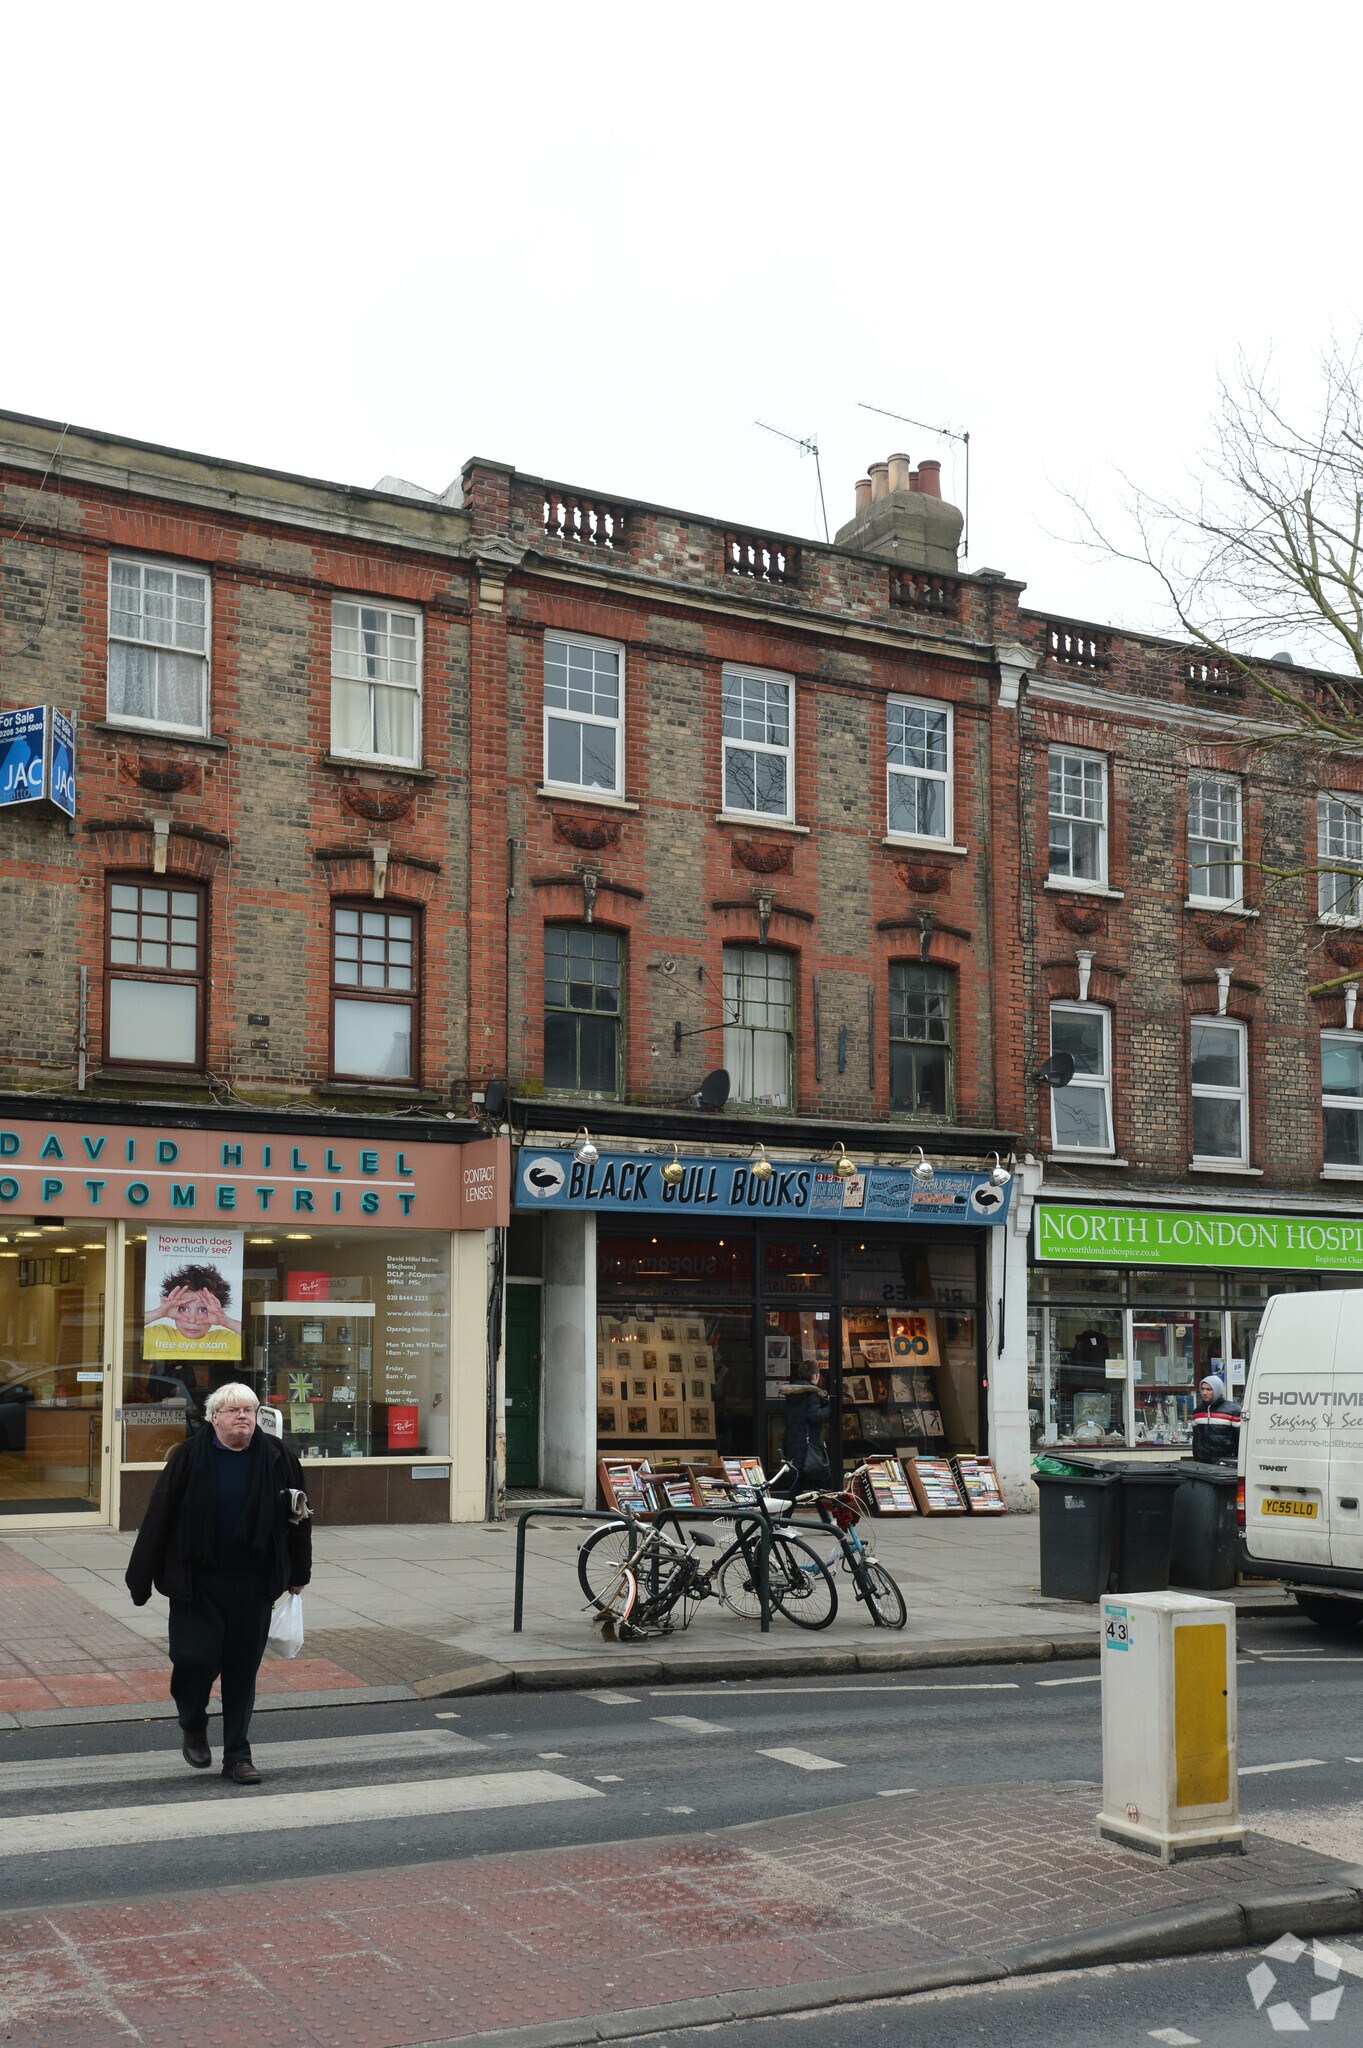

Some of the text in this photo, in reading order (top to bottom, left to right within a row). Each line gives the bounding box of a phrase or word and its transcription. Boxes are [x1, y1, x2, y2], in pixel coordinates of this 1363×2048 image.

[15, 711, 35, 725] Sale
[15, 726, 26, 735] 349
[28, 722, 43, 732] 5000
[4, 758, 42, 791] JAC
[0, 1131, 414, 1176] DAVID HILLEL
[463, 1166, 496, 1184] CONTACT
[567, 1160, 653, 1201] BLACK
[728, 1168, 810, 1208] BOOKS
[0, 1175, 416, 1216] OPTOMETRIST
[465, 1185, 494, 1203] LENSES
[1043, 1212, 1148, 1243] NORTH
[1156, 1218, 1277, 1249] LONDON
[158, 1243, 232, 1255] he actually see?
[159, 1235, 233, 1246] how much does
[1047, 1244, 1160, 1258] www.northlondonhospice.co.uk
[1315, 1254, 1348, 1265] Registered
[155, 1339, 176, 1349] free
[178, 1341, 197, 1350] eye
[1269, 1412, 1319, 1433] Staging
[1322, 1413, 1336, 1428] &
[1258, 1464, 1288, 1472] TRANSIT
[1266, 1500, 1313, 1516] YC55 LLO
[1107, 1622, 1127, 1640] 43
